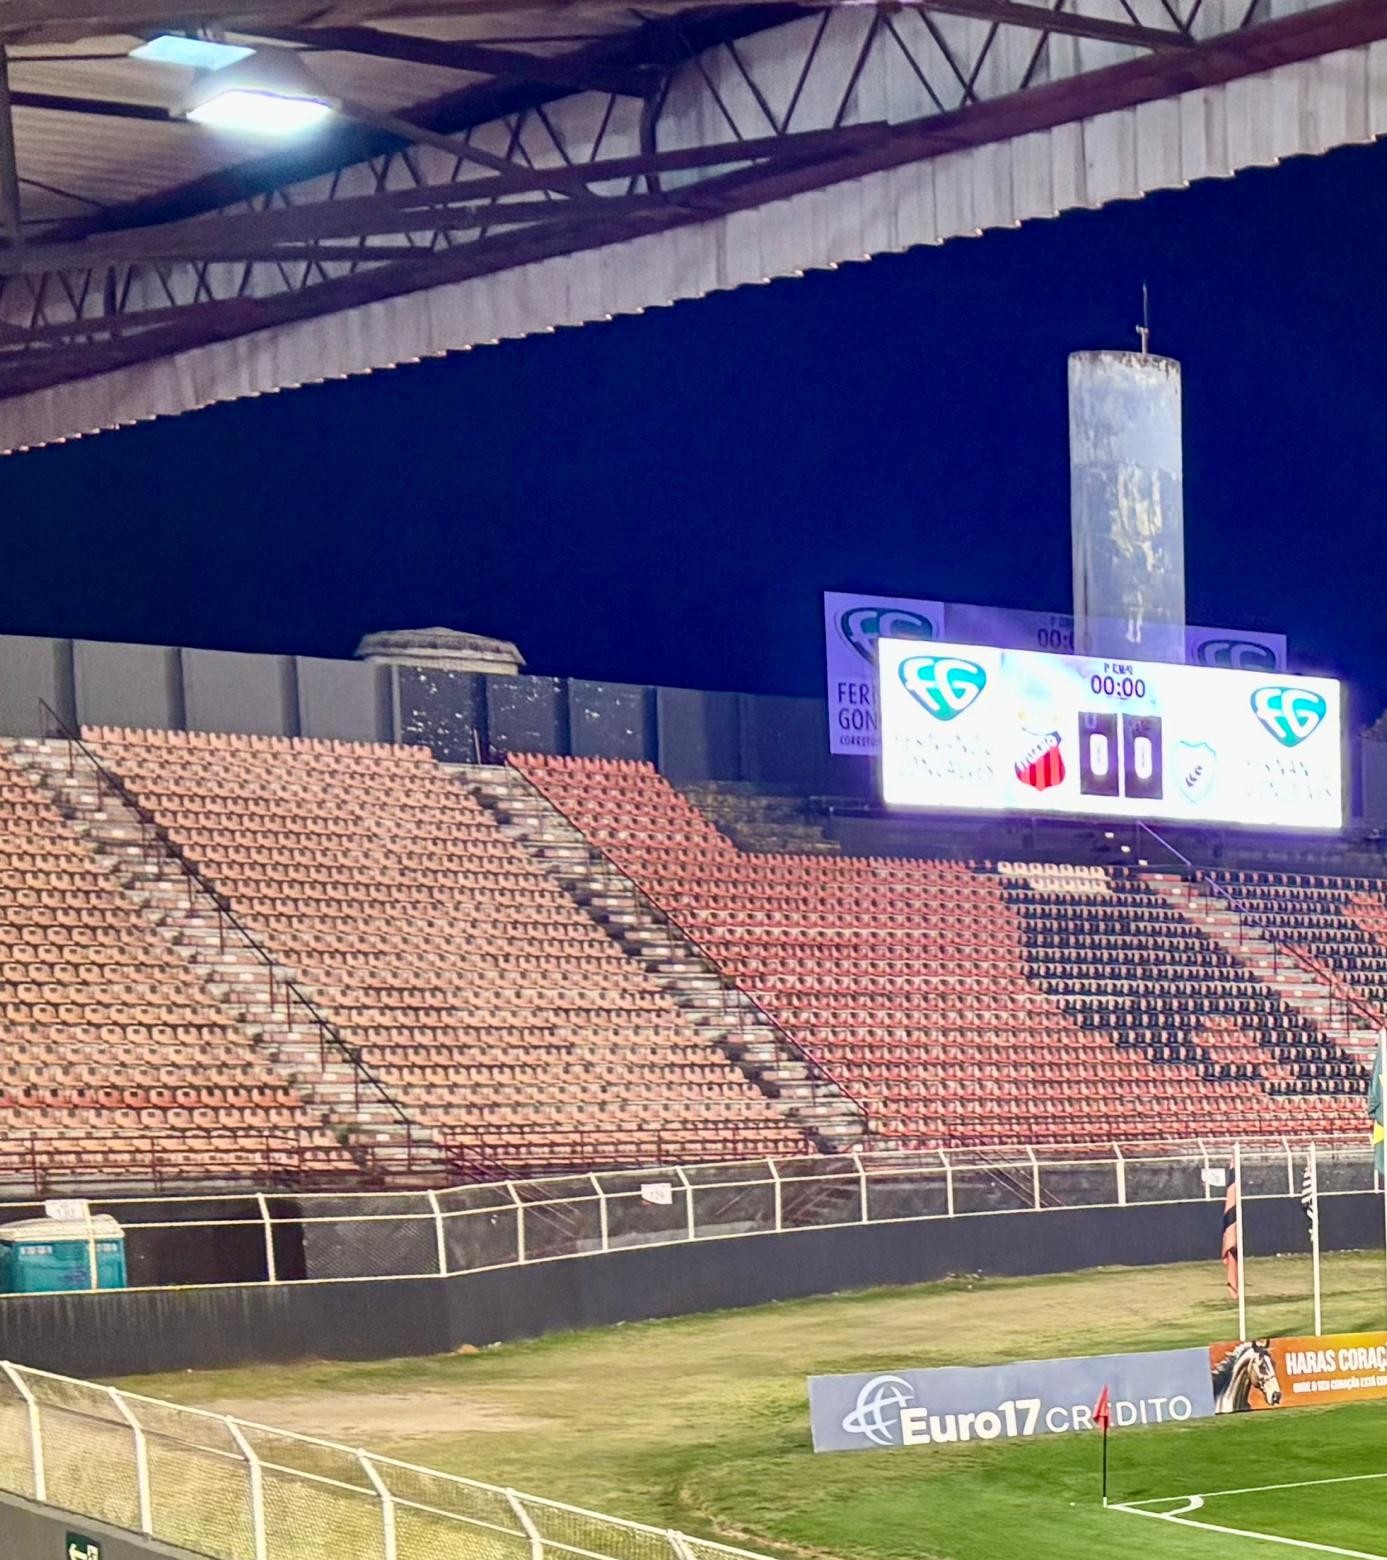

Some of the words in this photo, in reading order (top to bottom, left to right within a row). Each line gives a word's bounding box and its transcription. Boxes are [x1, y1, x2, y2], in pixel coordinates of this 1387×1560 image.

[1091, 674, 1145, 698] 00:00
[1285, 1350, 1337, 1376] HARAS
[901, 1398, 1040, 1446] Euro17
[1046, 1395, 1192, 1434] CRDITO
